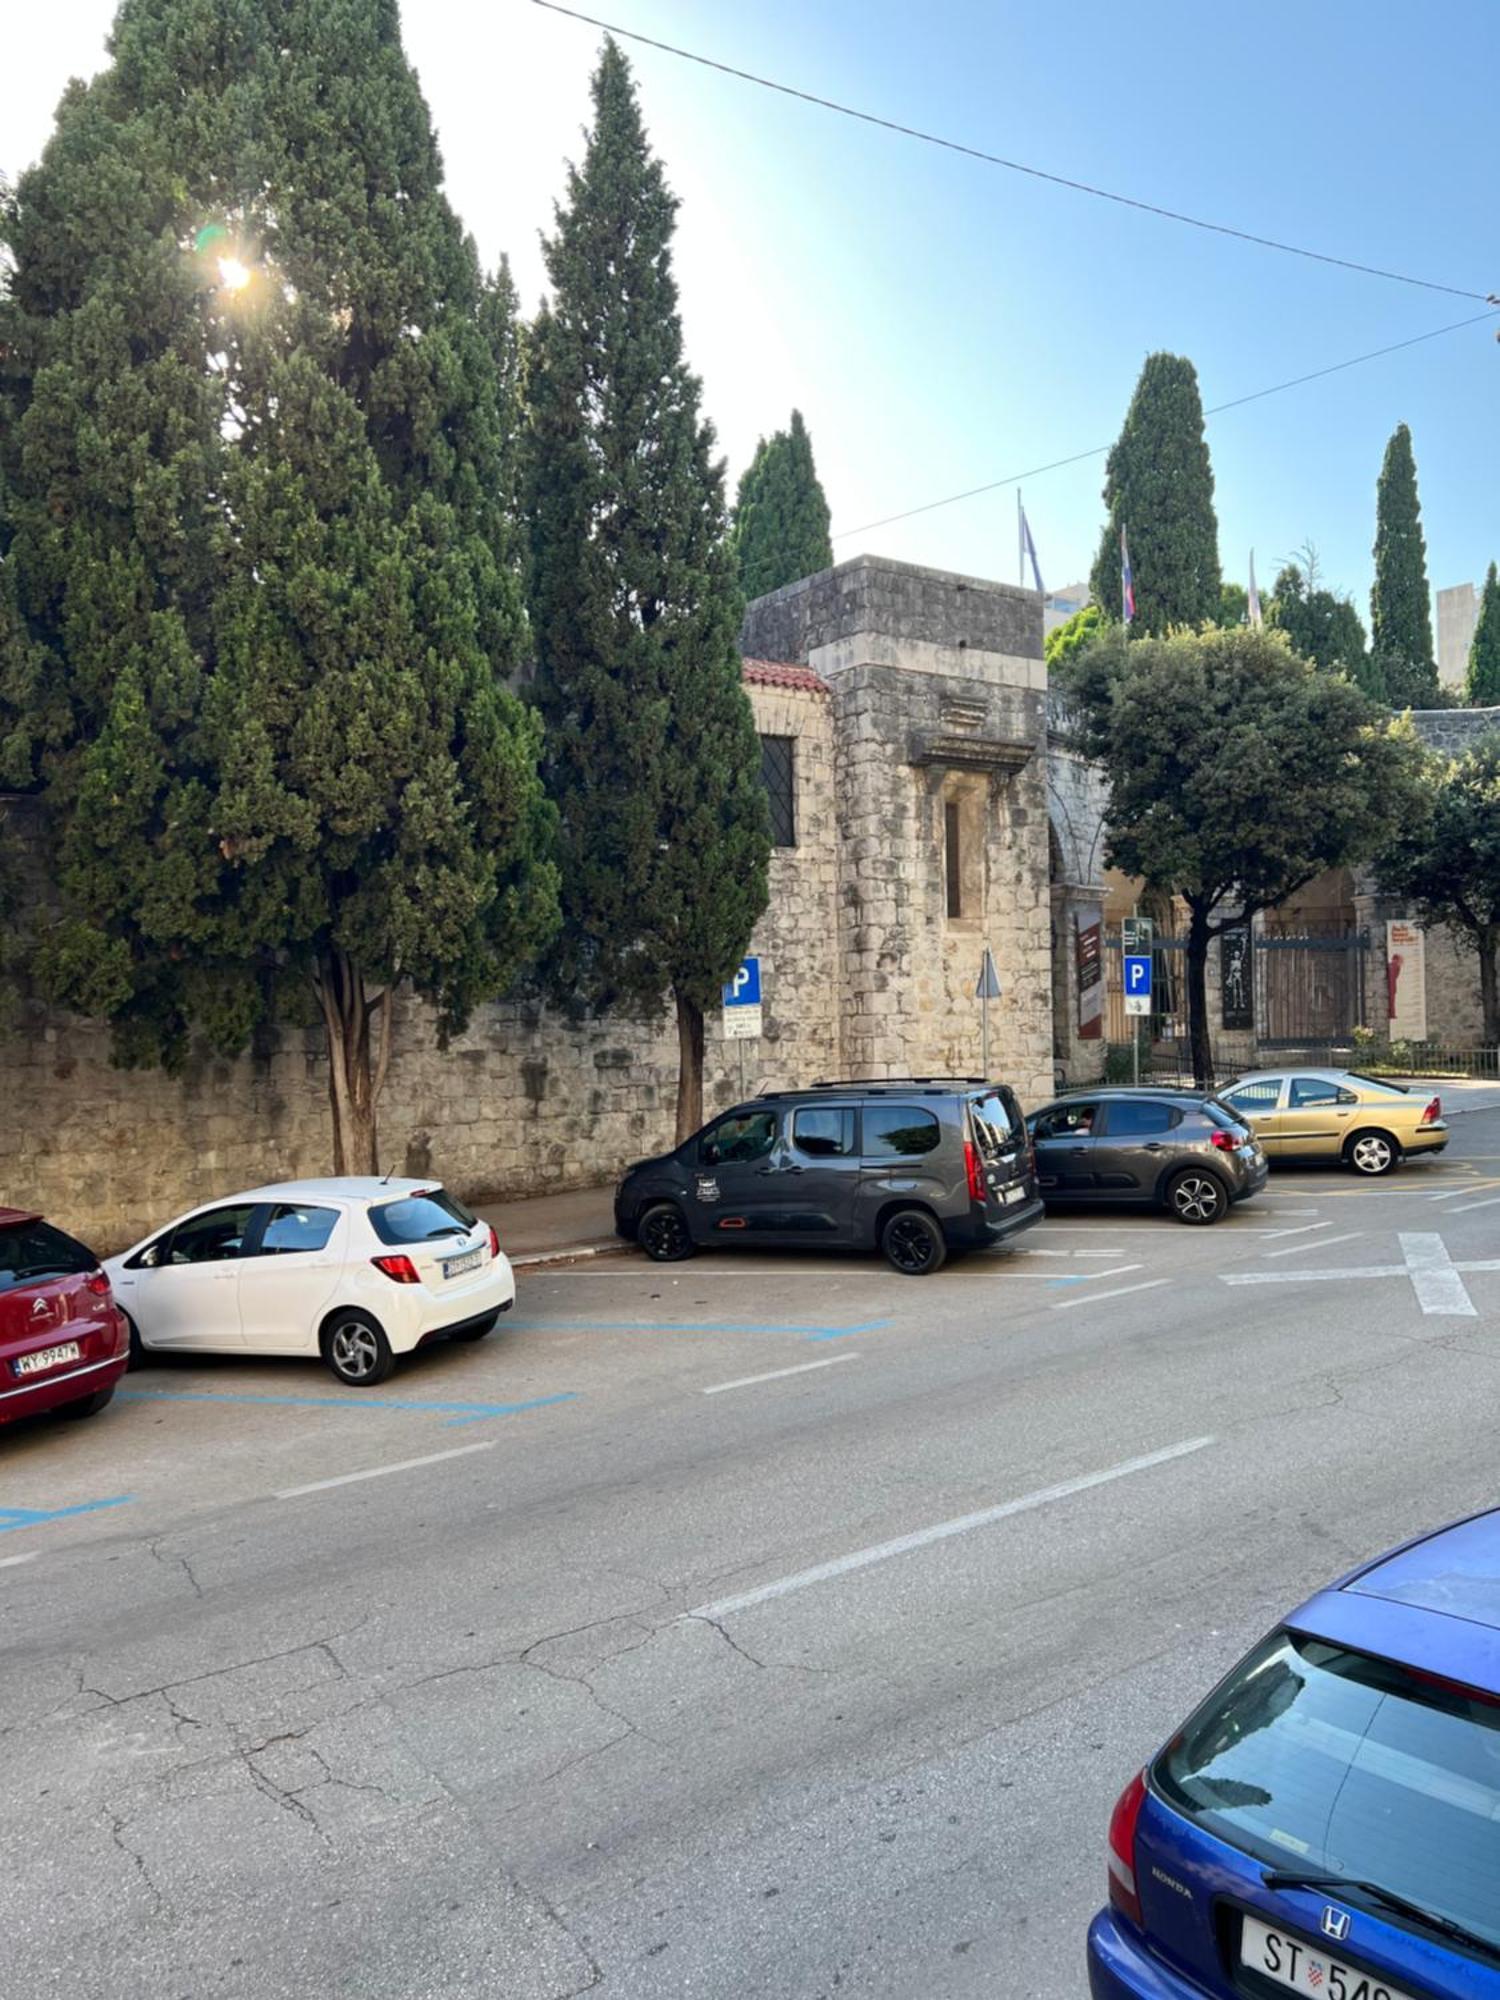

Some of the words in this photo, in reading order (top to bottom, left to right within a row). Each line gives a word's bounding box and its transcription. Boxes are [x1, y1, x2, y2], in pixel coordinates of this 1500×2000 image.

[734, 967, 749, 997] P
[1131, 964, 1144, 988] P
[1152, 1865, 1194, 1900] HONDA
[1264, 1933, 1303, 1982] ST
